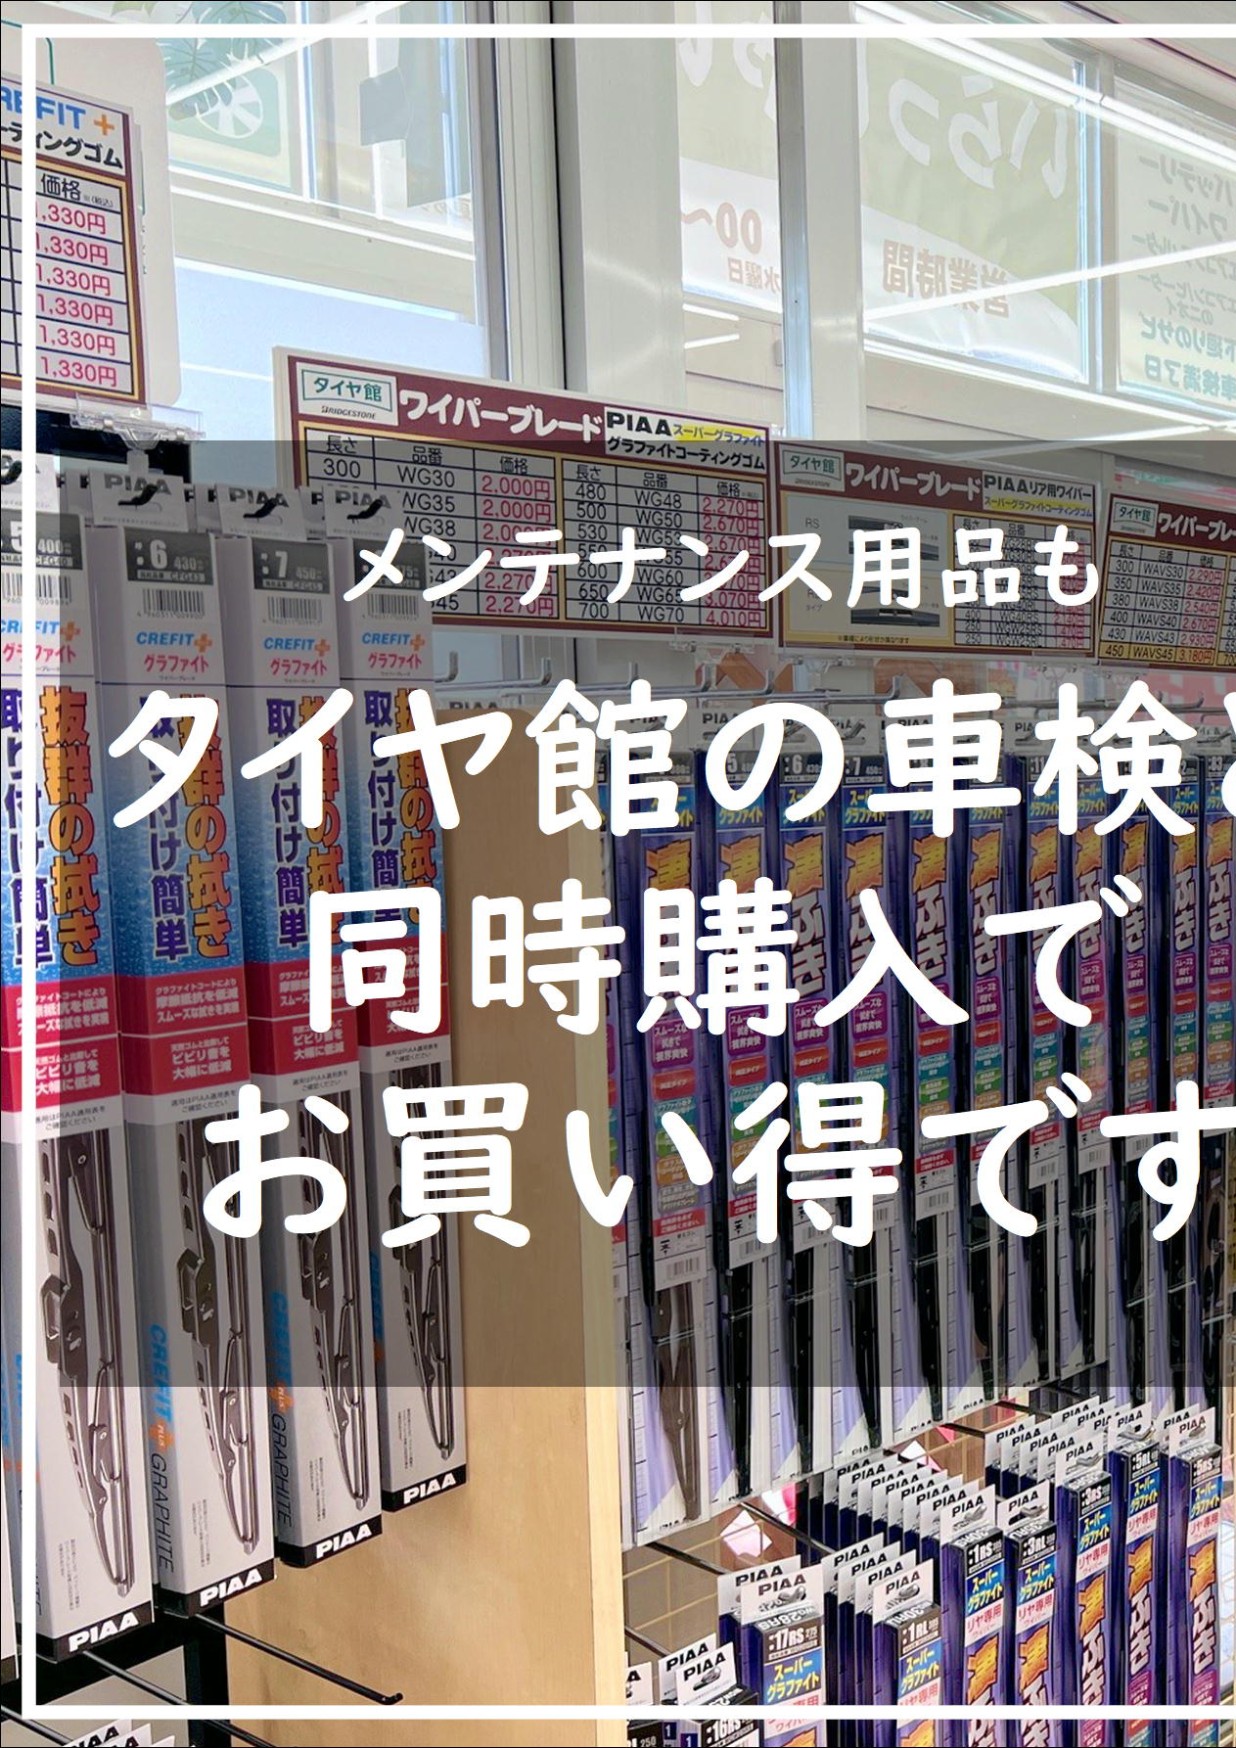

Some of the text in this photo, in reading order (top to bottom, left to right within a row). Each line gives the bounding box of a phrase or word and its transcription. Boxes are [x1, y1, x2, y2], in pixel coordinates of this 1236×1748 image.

[41, 173, 82, 201] 価格
[313, 376, 383, 402] タイヤ館
[399, 389, 603, 443] ワイパーブレード
[606, 411, 673, 437] PIAA
[673, 424, 765, 448] スーパーグラファイト
[326, 435, 528, 475] 長さ 品番 価格
[607, 436, 766, 470] グラファイトコーティングゴム
[323, 458, 456, 488] 300 WG30
[790, 455, 835, 475] タイヤ館
[576, 464, 741, 498] 長さ 品番 価格
[845, 463, 981, 502] ワイパーブレード
[984, 475, 1029, 494] PIAA
[1029, 481, 1092, 501] リア用ワイパー
[576, 484, 606, 500] 480
[635, 490, 682, 509] WG48
[577, 503, 607, 520] 500
[636, 509, 683, 528] WG50
[805, 517, 820, 529] RS
[1119, 506, 1151, 522] タイヤ館
[578, 525, 607, 540] 530
[578, 563, 683, 586] 600 WG60
[1116, 559, 1183, 579] 300 WAVS30
[579, 584, 609, 600] 650
[1114, 577, 1181, 596] 350 WAVS35
[579, 602, 609, 620] 700
[638, 605, 685, 623] WG70
[1112, 594, 1179, 611] 380 WAVS38
[1110, 611, 1177, 628] 400 WAVS40
[136, 632, 195, 646] CREFIT
[263, 637, 315, 651] CREFIT
[362, 632, 411, 646] CREFIT
[1108, 627, 1175, 643] 430 WAVS43
[368, 652, 422, 670] グラファイト
[1106, 644, 1173, 660] 450 WAVS45
[144, 655, 209, 673] グラファイト
[270, 658, 327, 676] グラファイト
[39, 686, 100, 967] 抜群の拭き
[271, 1412, 293, 1529] GRAPHITE
[403, 1472, 457, 1505] PIAA
[150, 1452, 174, 1574] GRAPHITE
[952, 1495, 985, 1517] PIAA
[1008, 1491, 1039, 1512] PIAA
[316, 1522, 373, 1560] PIAA
[834, 1544, 870, 1567] PIAA
[851, 1553, 887, 1576] PIAA
[735, 1564, 784, 1587] PIAA
[757, 1573, 807, 1597] PIAA
[868, 1562, 904, 1586] PIAA
[885, 1570, 920, 1595] PIAA
[200, 1568, 264, 1608] PIAA
[67, 1610, 139, 1652] PIAA
[665, 1642, 710, 1672] PIAA
[683, 1651, 727, 1682] PIAA
[775, 1657, 814, 1680] スーパー
[766, 1670, 821, 1701] グラファイト
